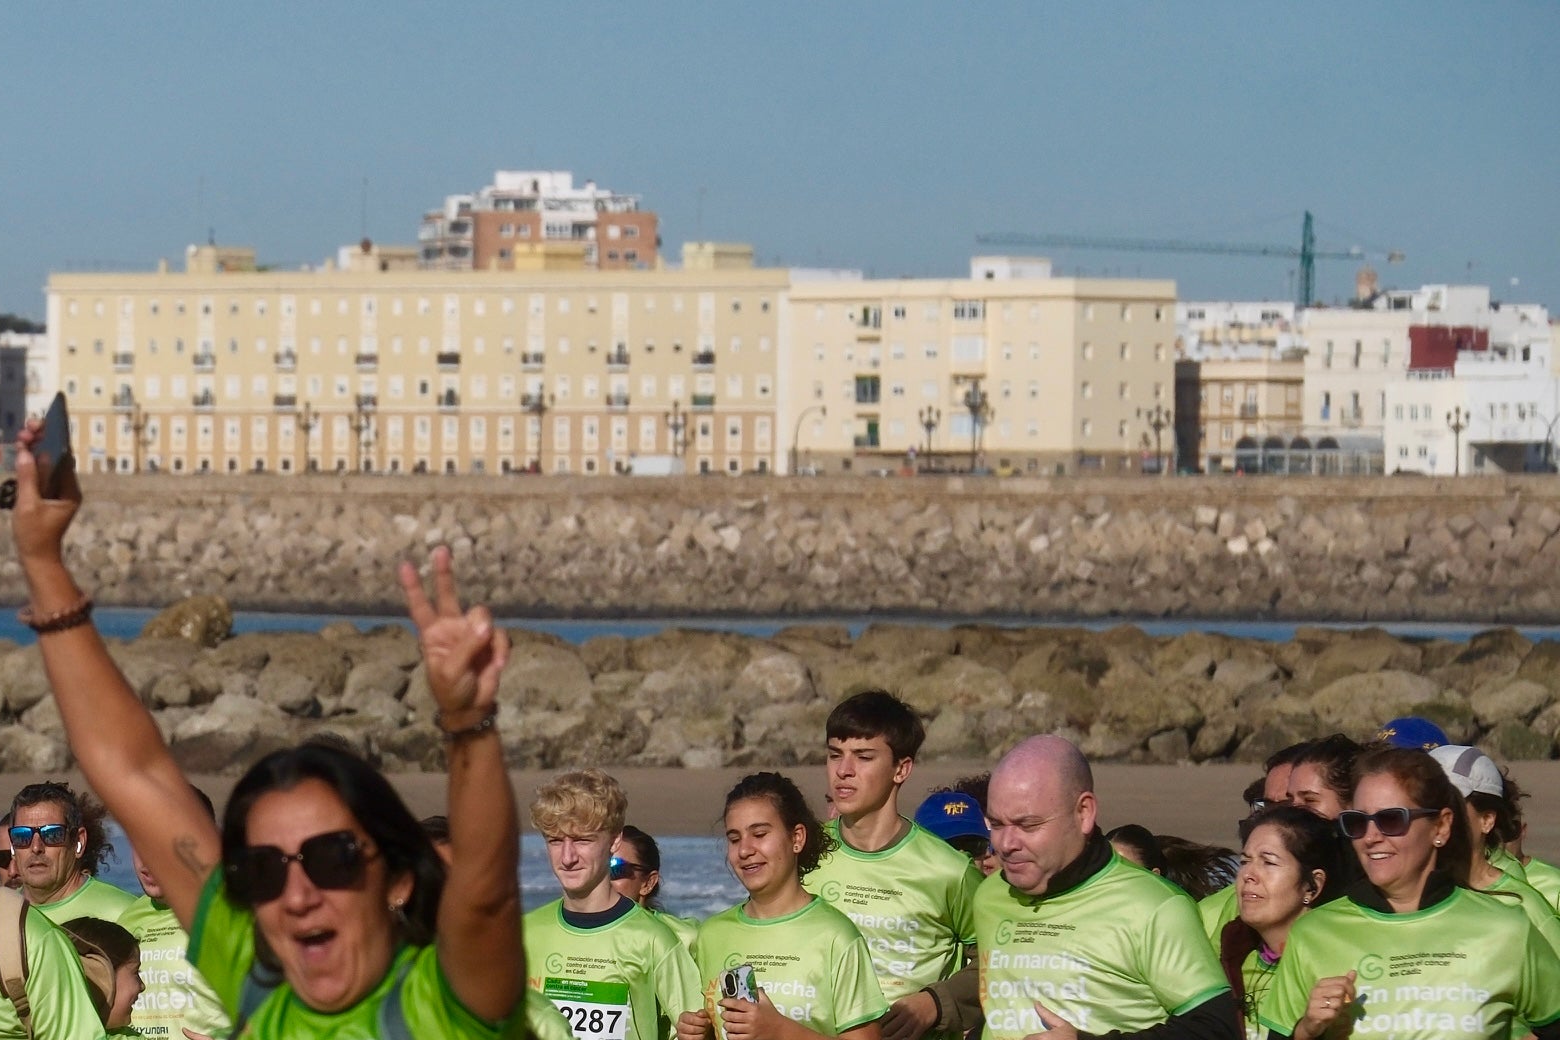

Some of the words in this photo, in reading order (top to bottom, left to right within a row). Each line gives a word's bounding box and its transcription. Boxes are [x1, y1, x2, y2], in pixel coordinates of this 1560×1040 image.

[989, 949, 1011, 969] En
[1389, 961, 1415, 970] contra
[1390, 952, 1430, 961] asociación
[1432, 951, 1467, 959] española
[758, 979, 816, 999] archa
[1395, 981, 1490, 1004] marcha
[790, 1003, 812, 1022] el
[1355, 1006, 1456, 1034] contra
[1459, 1008, 1485, 1033] el
